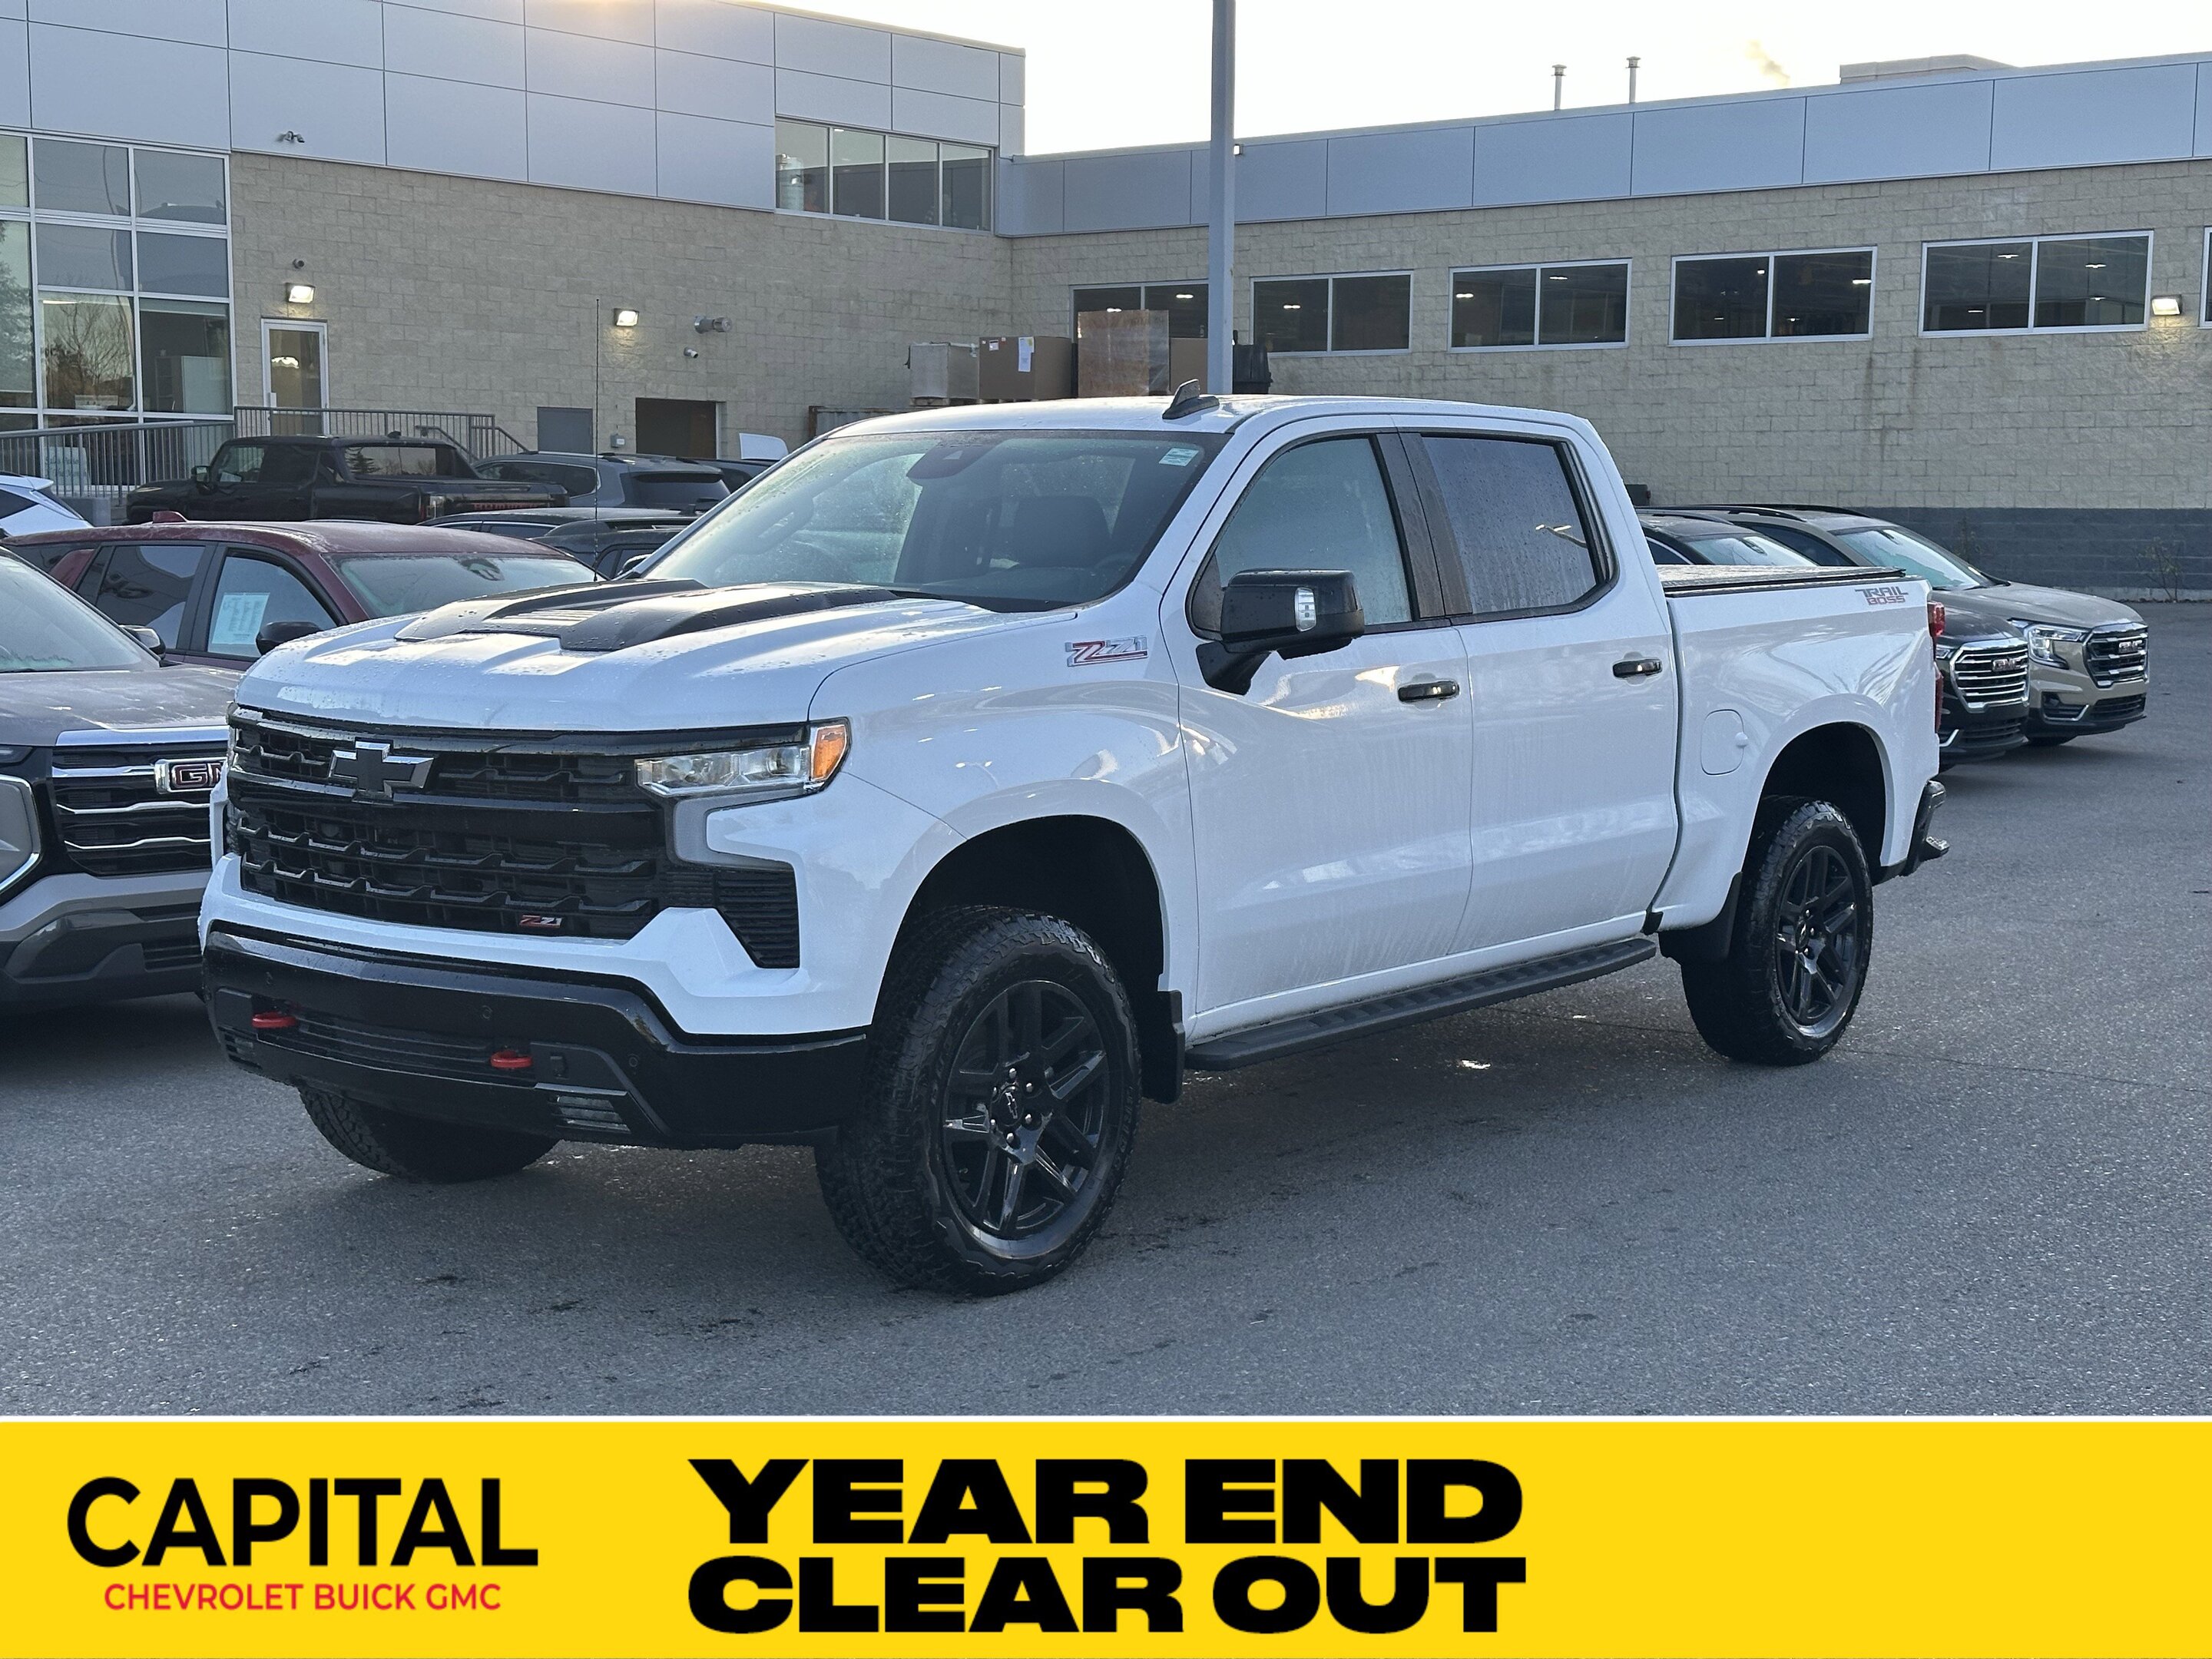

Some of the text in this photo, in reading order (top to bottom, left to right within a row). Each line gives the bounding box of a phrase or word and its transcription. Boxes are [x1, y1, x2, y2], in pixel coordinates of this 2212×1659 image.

[1855, 586, 1909, 598] TRAIL
[1866, 595, 1906, 605] BOSS
[1065, 635, 1148, 667] Z71
[1992, 657, 2022, 671] GMC
[519, 915, 562, 928] Z71
